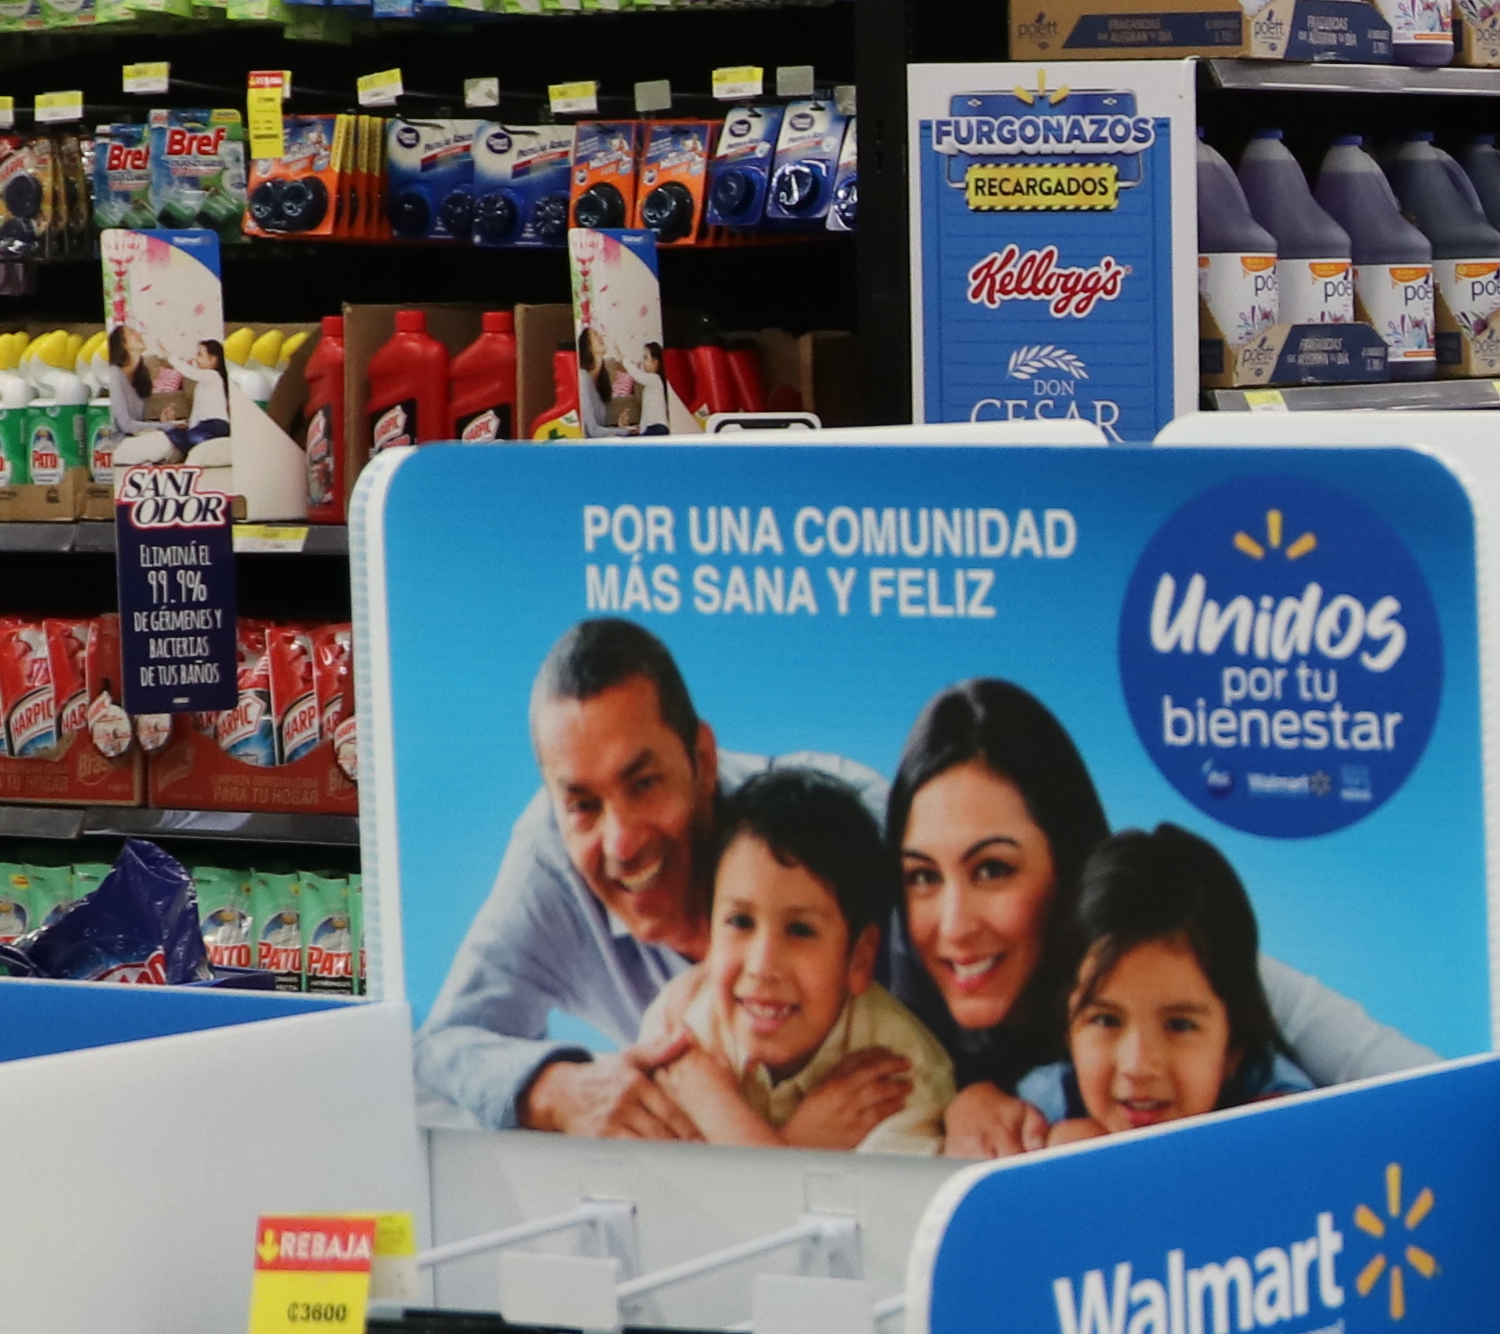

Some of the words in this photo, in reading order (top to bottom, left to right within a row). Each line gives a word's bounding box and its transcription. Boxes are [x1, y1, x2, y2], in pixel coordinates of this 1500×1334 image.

[166, 126, 227, 159] Bref
[934, 114, 1153, 151] FURGONAZOS
[974, 176, 1110, 198] RECARGADOS
[968, 244, 1123, 316] Kellogg's
[1034, 378, 1075, 396] DON
[125, 469, 198, 501] SANI
[134, 495, 225, 525] ODOR
[583, 505, 675, 555] POR
[689, 506, 781, 556] UNA
[793, 507, 1078, 559] COMUNIDAD
[140, 541, 196, 568] ELIMINÁ
[199, 544, 212, 567] EL
[148, 570, 208, 604] 99.9%
[585, 554, 681, 614] MÁS
[694, 565, 820, 615] SANA
[827, 569, 857, 615] Y
[870, 568, 996, 619] FELIZ
[134, 611, 149, 632] DE
[151, 606, 212, 632] GÉRMENES
[214, 609, 223, 628] Y
[1150, 572, 1407, 673] Unidos
[149, 636, 210, 660] BACTERIAS
[140, 666, 154, 686] DE
[156, 665, 178, 685] TUS
[180, 660, 220, 685] BAÑOS
[1222, 666, 1287, 708] por
[1297, 662, 1337, 701] tu
[1163, 696, 1404, 751] bienestar
[280, 1231, 372, 1261] REBAJA
